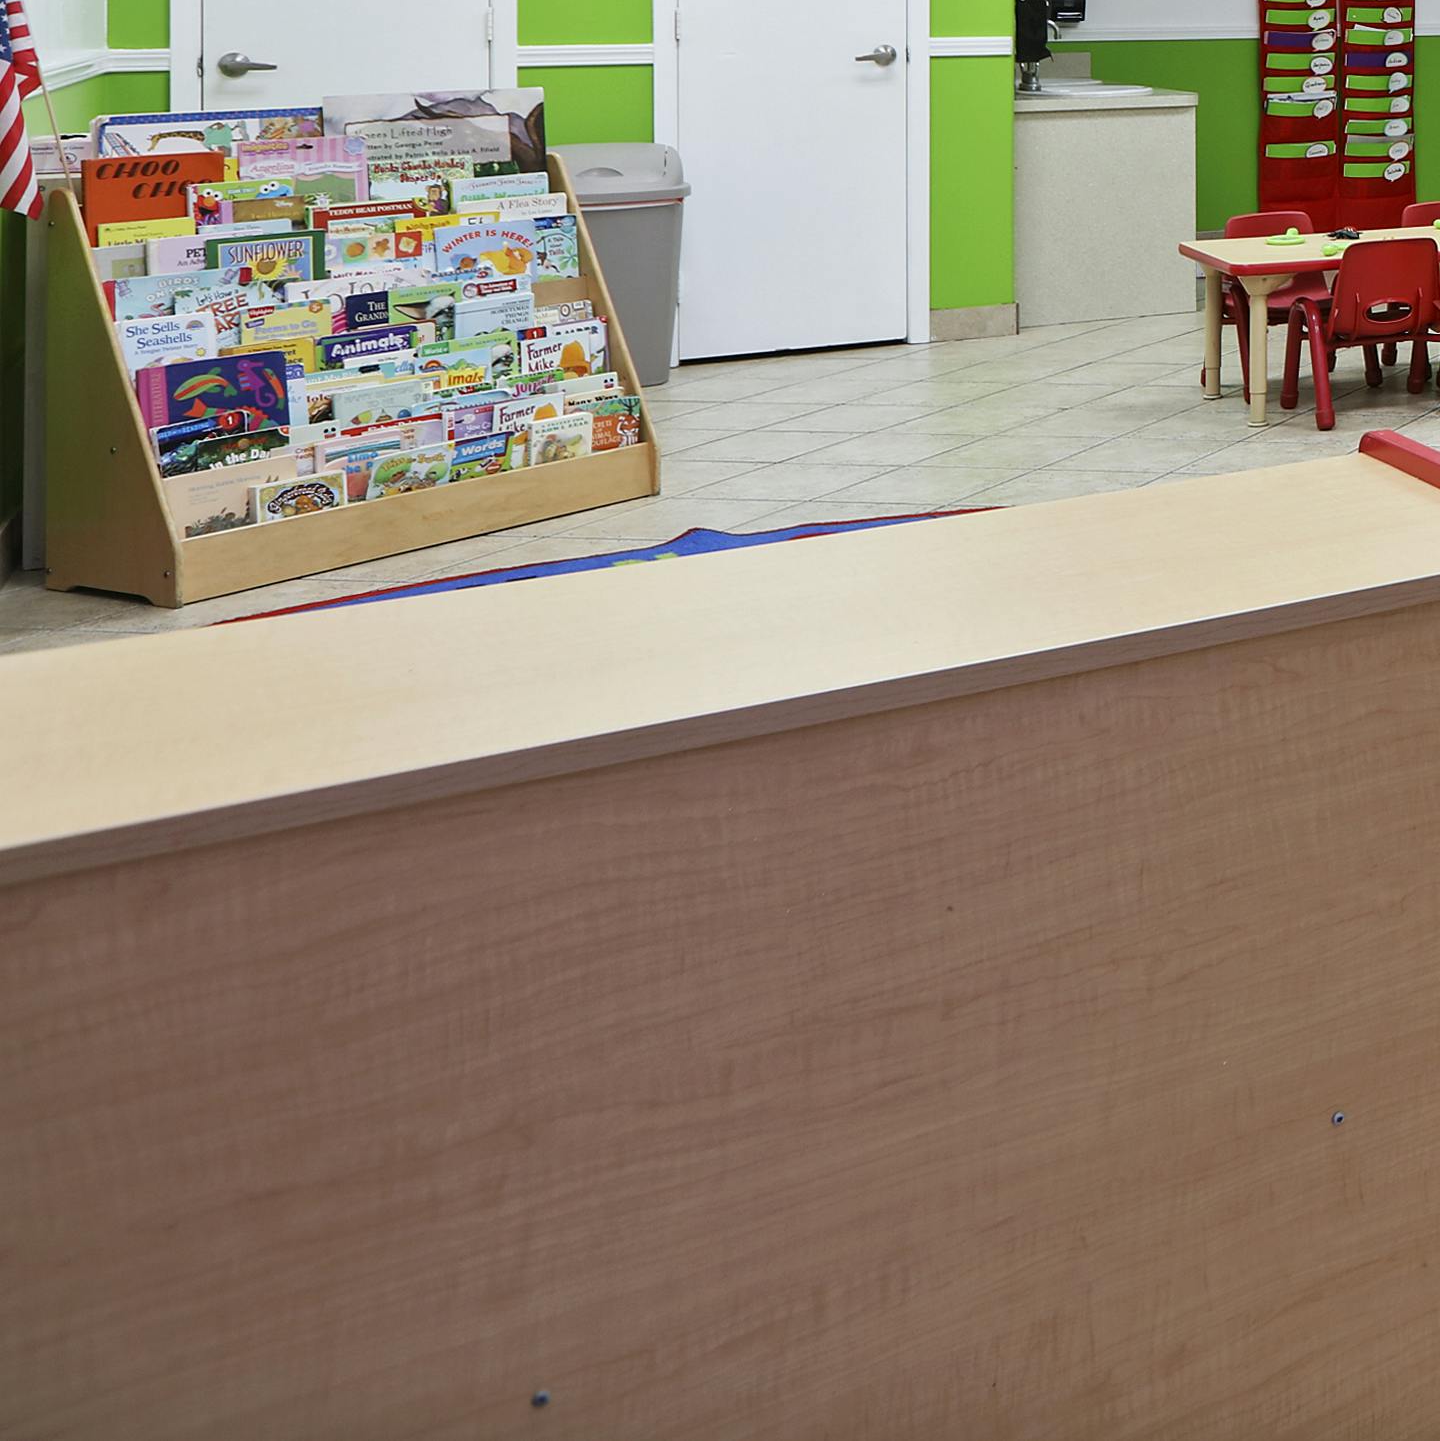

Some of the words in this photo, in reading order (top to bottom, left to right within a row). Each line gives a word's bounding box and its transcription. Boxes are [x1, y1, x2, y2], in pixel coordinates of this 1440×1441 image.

[391, 128, 423, 139] Lifted
[426, 127, 453, 137] High
[395, 141, 422, 150] Georgia
[96, 159, 180, 180] CHOO
[329, 207, 355, 216] TEDDY
[355, 205, 376, 215] BEAR
[377, 203, 413, 214] POSTMAN
[498, 202, 505, 210] A
[507, 199, 529, 209] Flea
[531, 198, 559, 208] Story
[442, 231, 481, 253] WINTER
[486, 229, 496, 237] IS
[501, 231, 534, 248] HERE!
[228, 241, 304, 265] SUNFLOWER
[159, 277, 199, 288] BIRDS
[146, 290, 165, 302] ON
[367, 301, 386, 310] THE
[125, 326, 148, 338] She
[151, 321, 180, 335] Sells
[532, 330, 539, 338] 1
[137, 333, 193, 350] Seashells
[527, 341, 562, 360] Farmer
[528, 359, 554, 373] Mike
[449, 372, 484, 385] imals
[227, 416, 233, 425] 1
[500, 405, 535, 424] Farmer
[592, 432, 611, 440] NIMAL
[462, 439, 504, 456] Words
[225, 452, 247, 464] the
[250, 448, 271, 459] Dar
